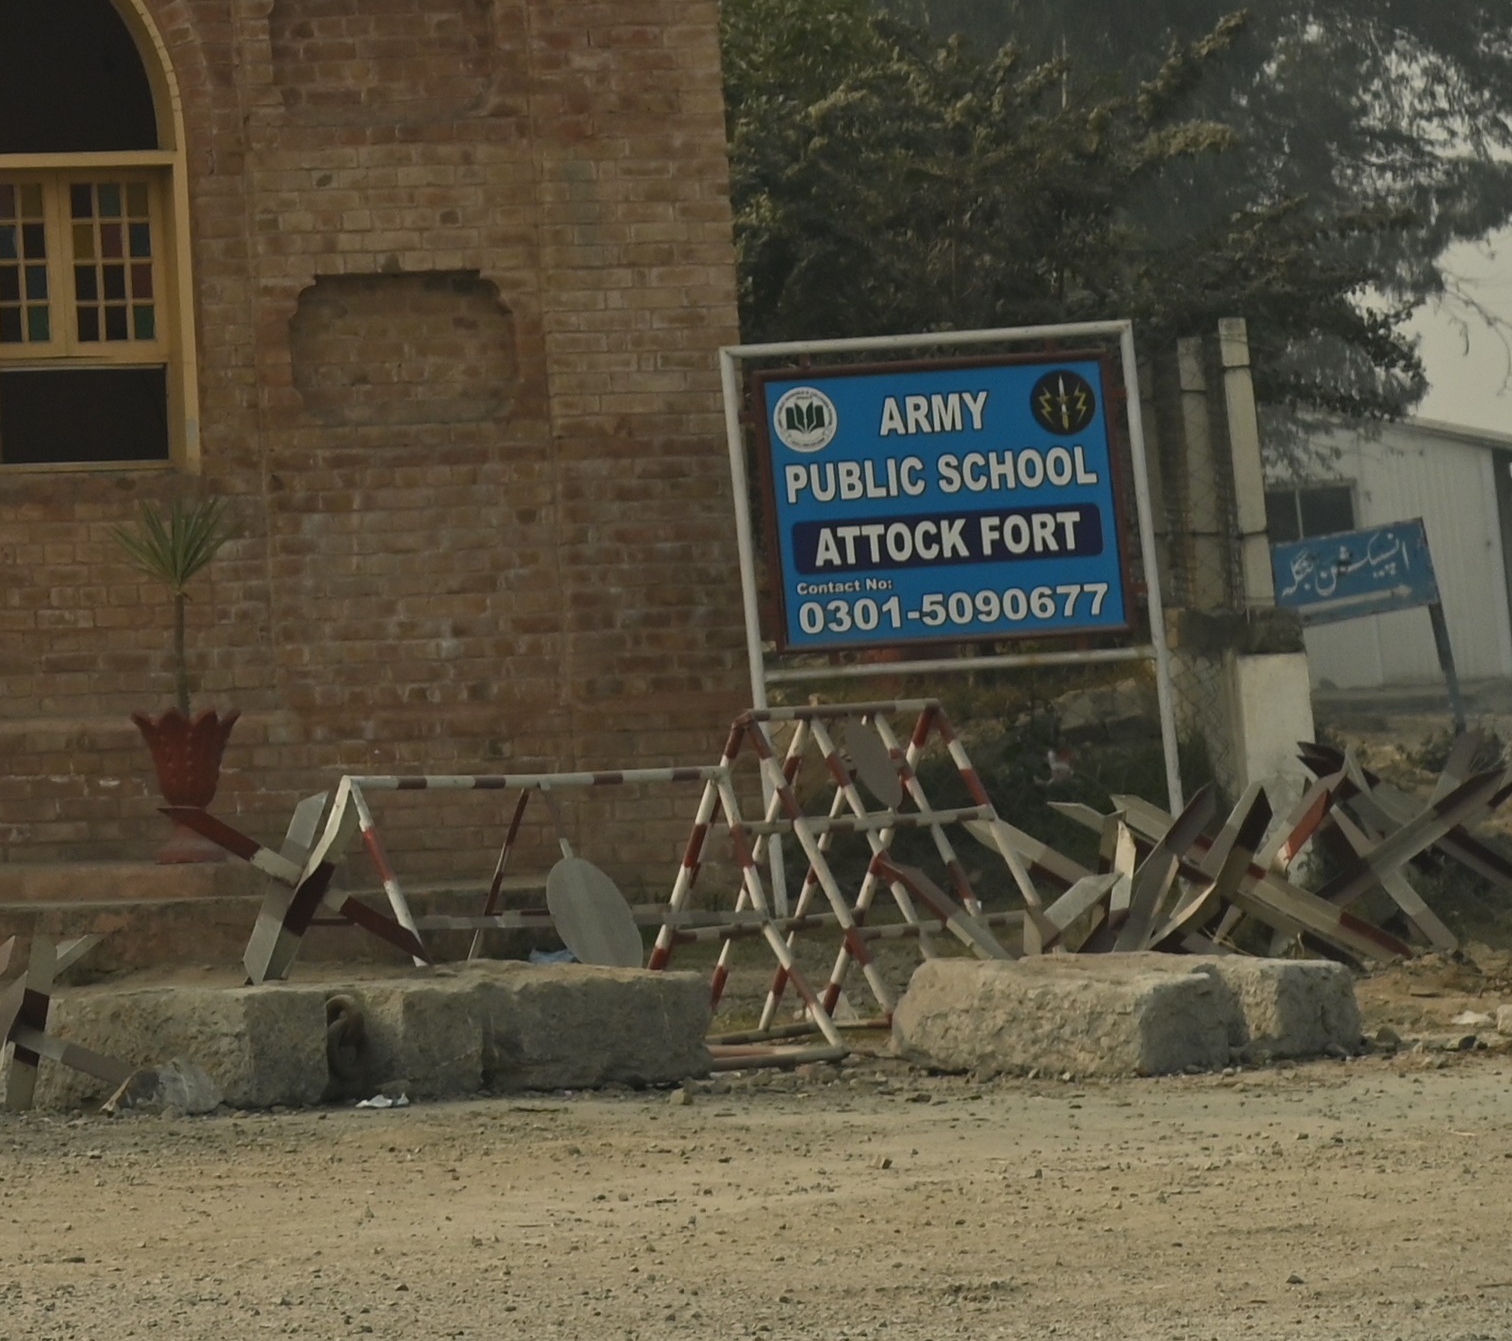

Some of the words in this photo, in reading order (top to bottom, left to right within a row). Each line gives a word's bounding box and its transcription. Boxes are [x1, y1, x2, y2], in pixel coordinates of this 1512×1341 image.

[879, 390, 988, 436] ARMY
[784, 456, 926, 505] PUBLIC
[937, 445, 1099, 495] SCHOOL
[814, 517, 971, 567] ATTOCK
[979, 510, 1082, 557] FORT
[796, 578, 861, 596] Contact
[865, 577, 894, 592] No:
[797, 581, 1109, 635] 0301-5090677
